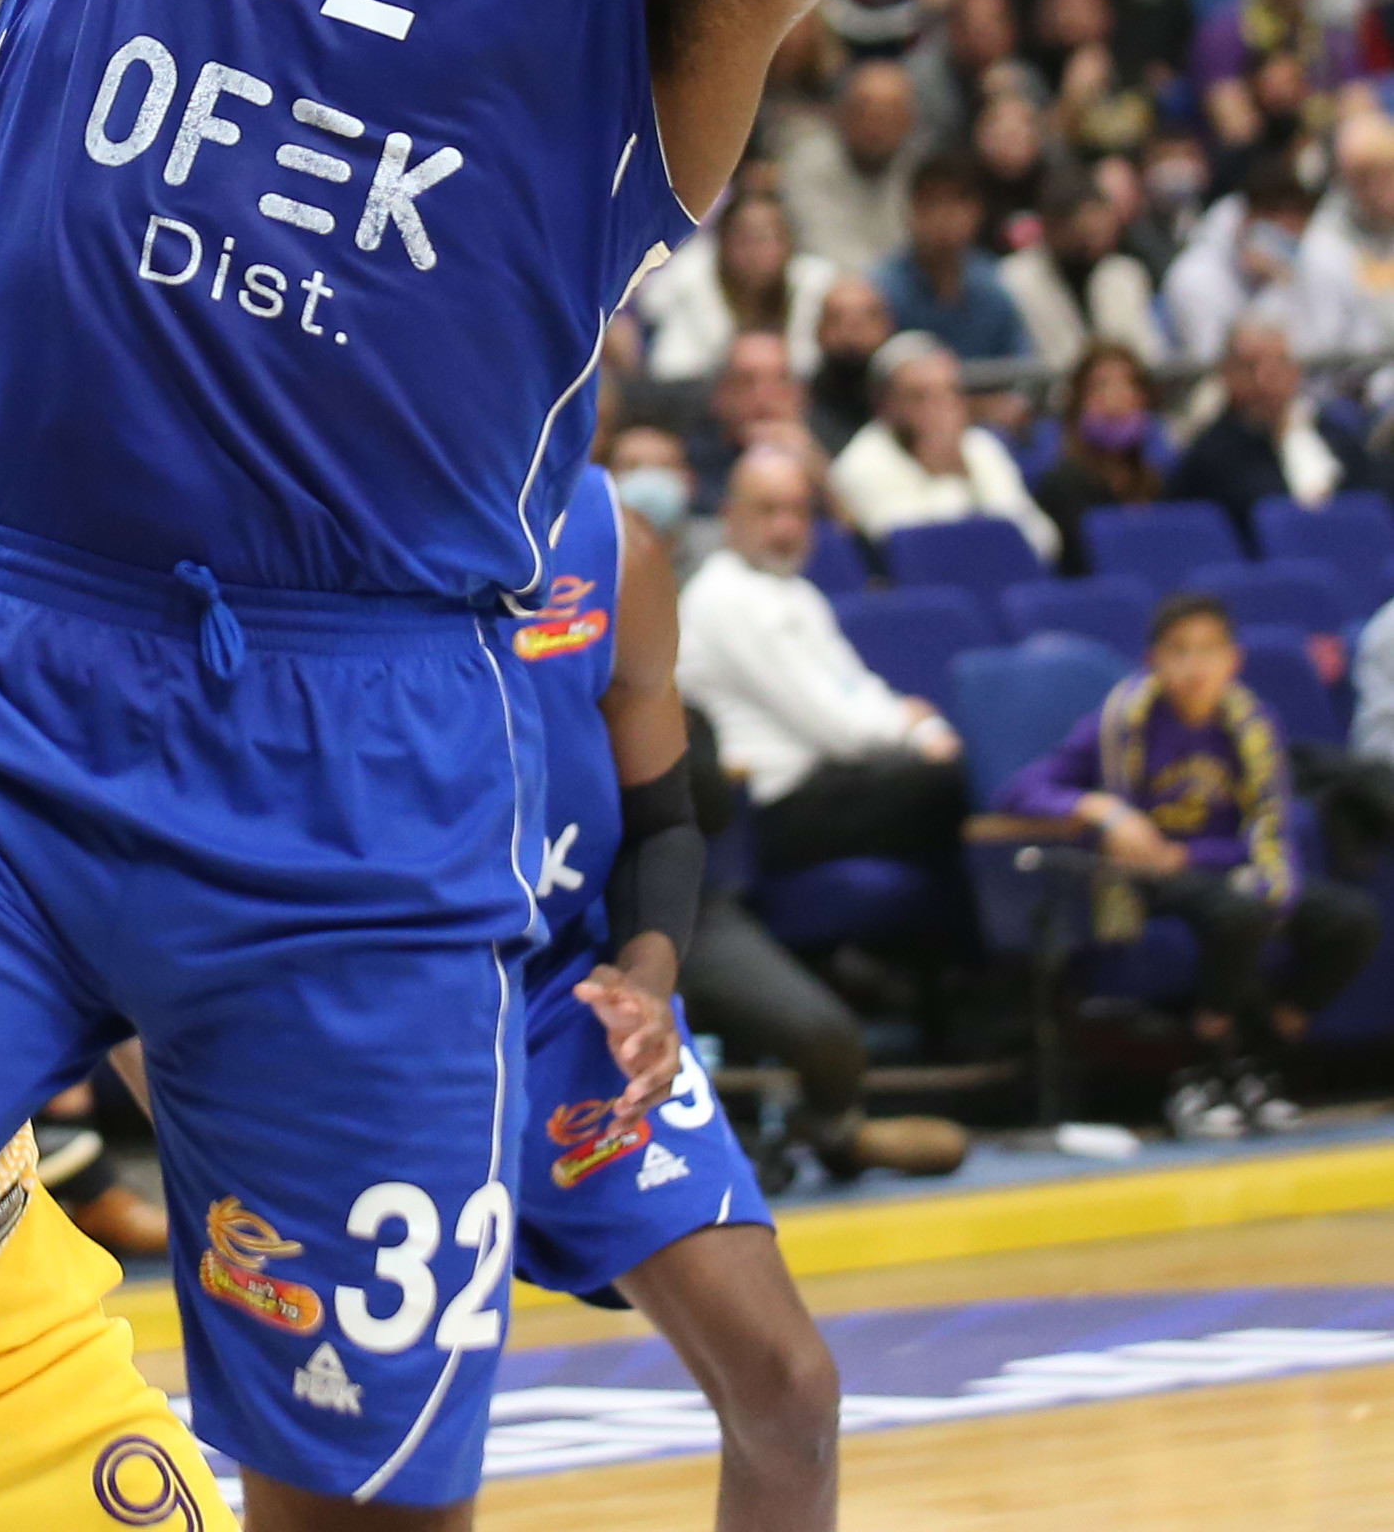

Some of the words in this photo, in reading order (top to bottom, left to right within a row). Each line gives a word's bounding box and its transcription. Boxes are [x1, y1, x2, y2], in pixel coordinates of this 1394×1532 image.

[84, 35, 464, 271] OFEK
[138, 214, 348, 345] Dist.
[334, 1180, 514, 1354] 32
[92, 1434, 205, 1532] 9
